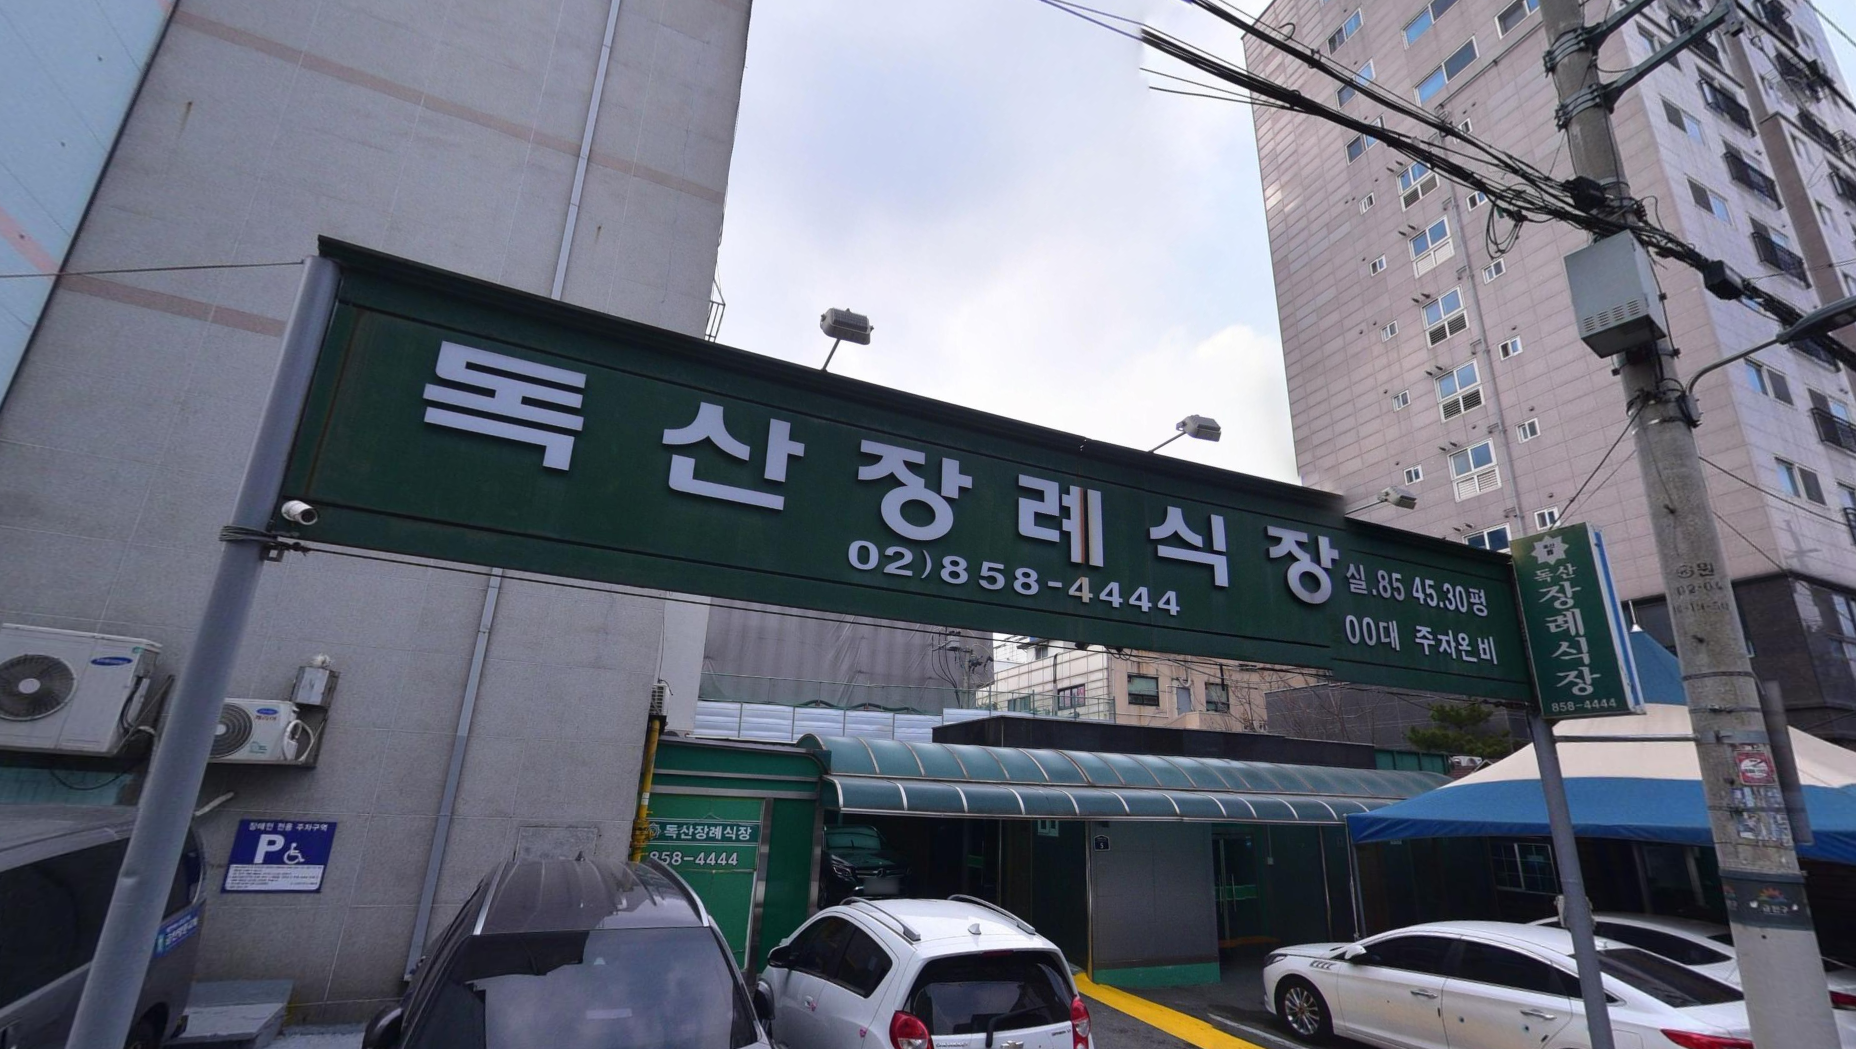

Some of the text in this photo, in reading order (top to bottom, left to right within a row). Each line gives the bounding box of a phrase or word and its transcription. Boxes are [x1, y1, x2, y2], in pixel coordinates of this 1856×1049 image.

[847, 540, 1181, 616] 02)858-4444
[1534, 563, 1577, 582] 독산
[1412, 576, 1488, 617] 45.30평
[1551, 698, 1617, 712] 858-4444
[663, 823, 752, 841] 독산장례식장
[253, 833, 286, 864] P
